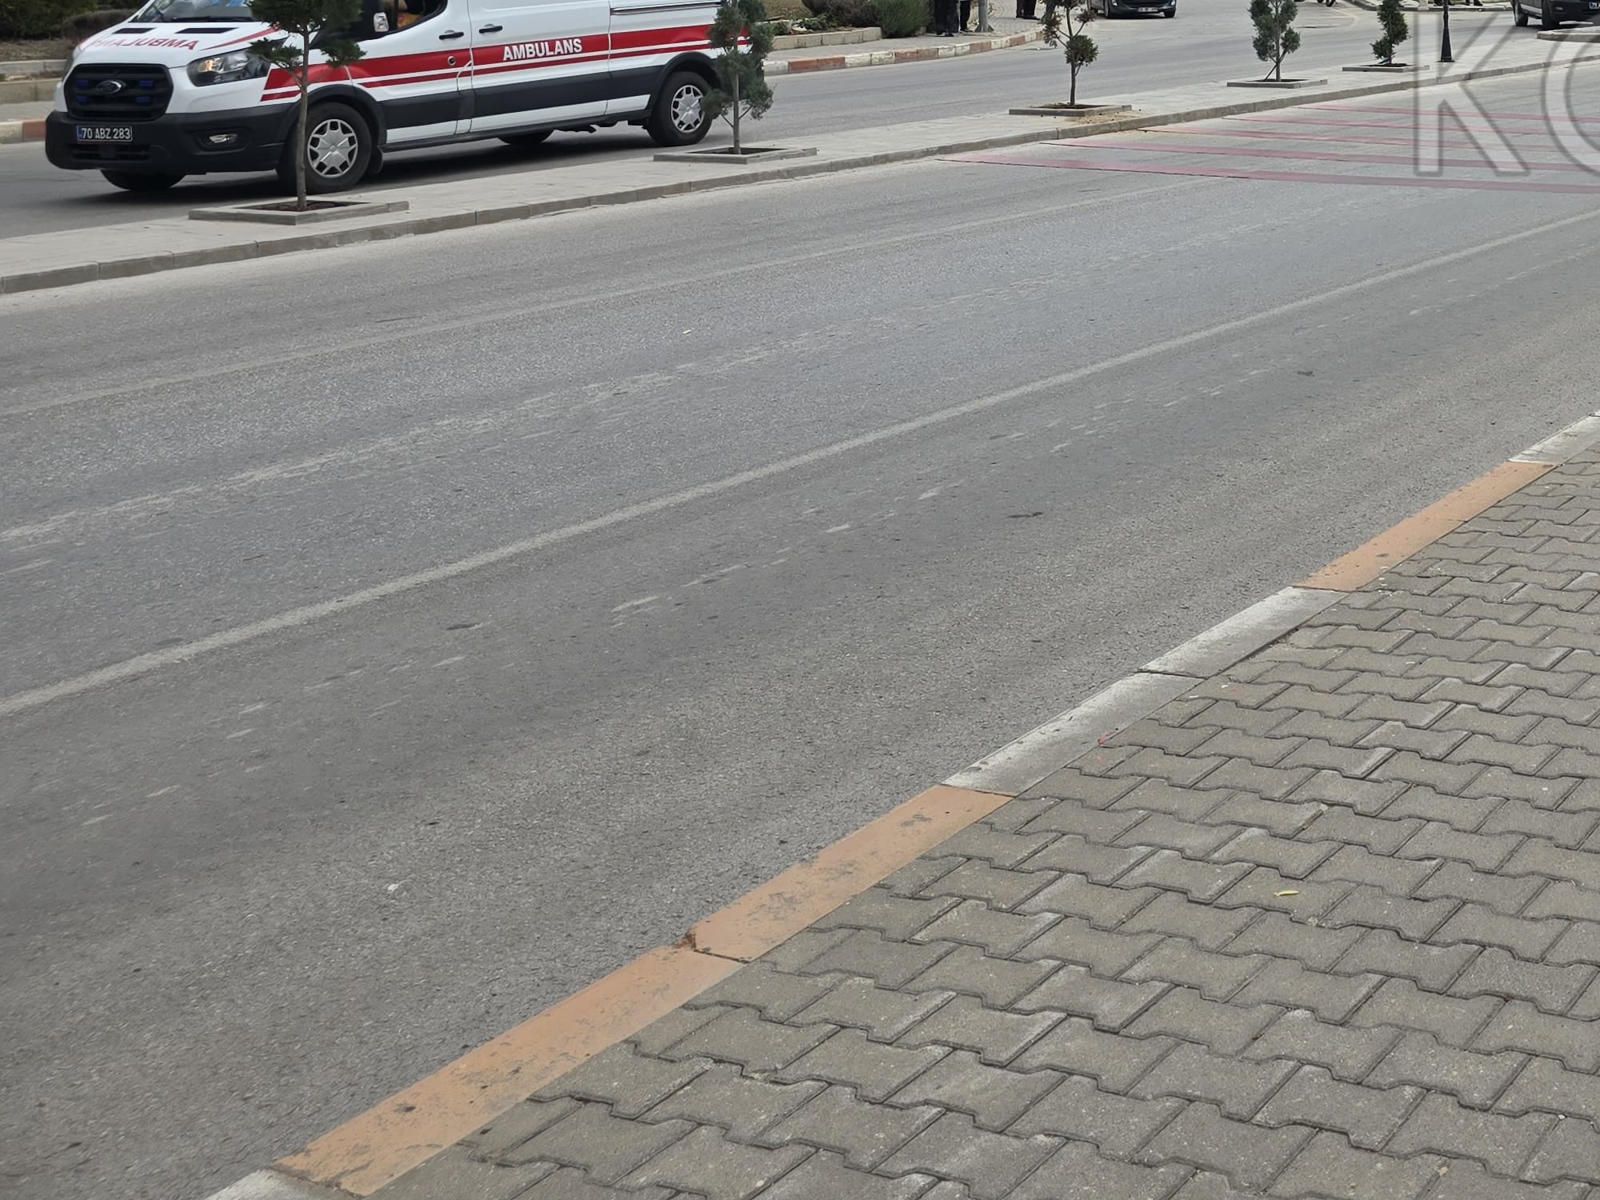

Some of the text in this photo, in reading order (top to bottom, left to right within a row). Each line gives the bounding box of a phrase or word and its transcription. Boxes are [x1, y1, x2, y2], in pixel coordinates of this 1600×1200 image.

[503, 38, 582, 61] AMBULANS
[82, 127, 131, 139] 70 ABZ 283
